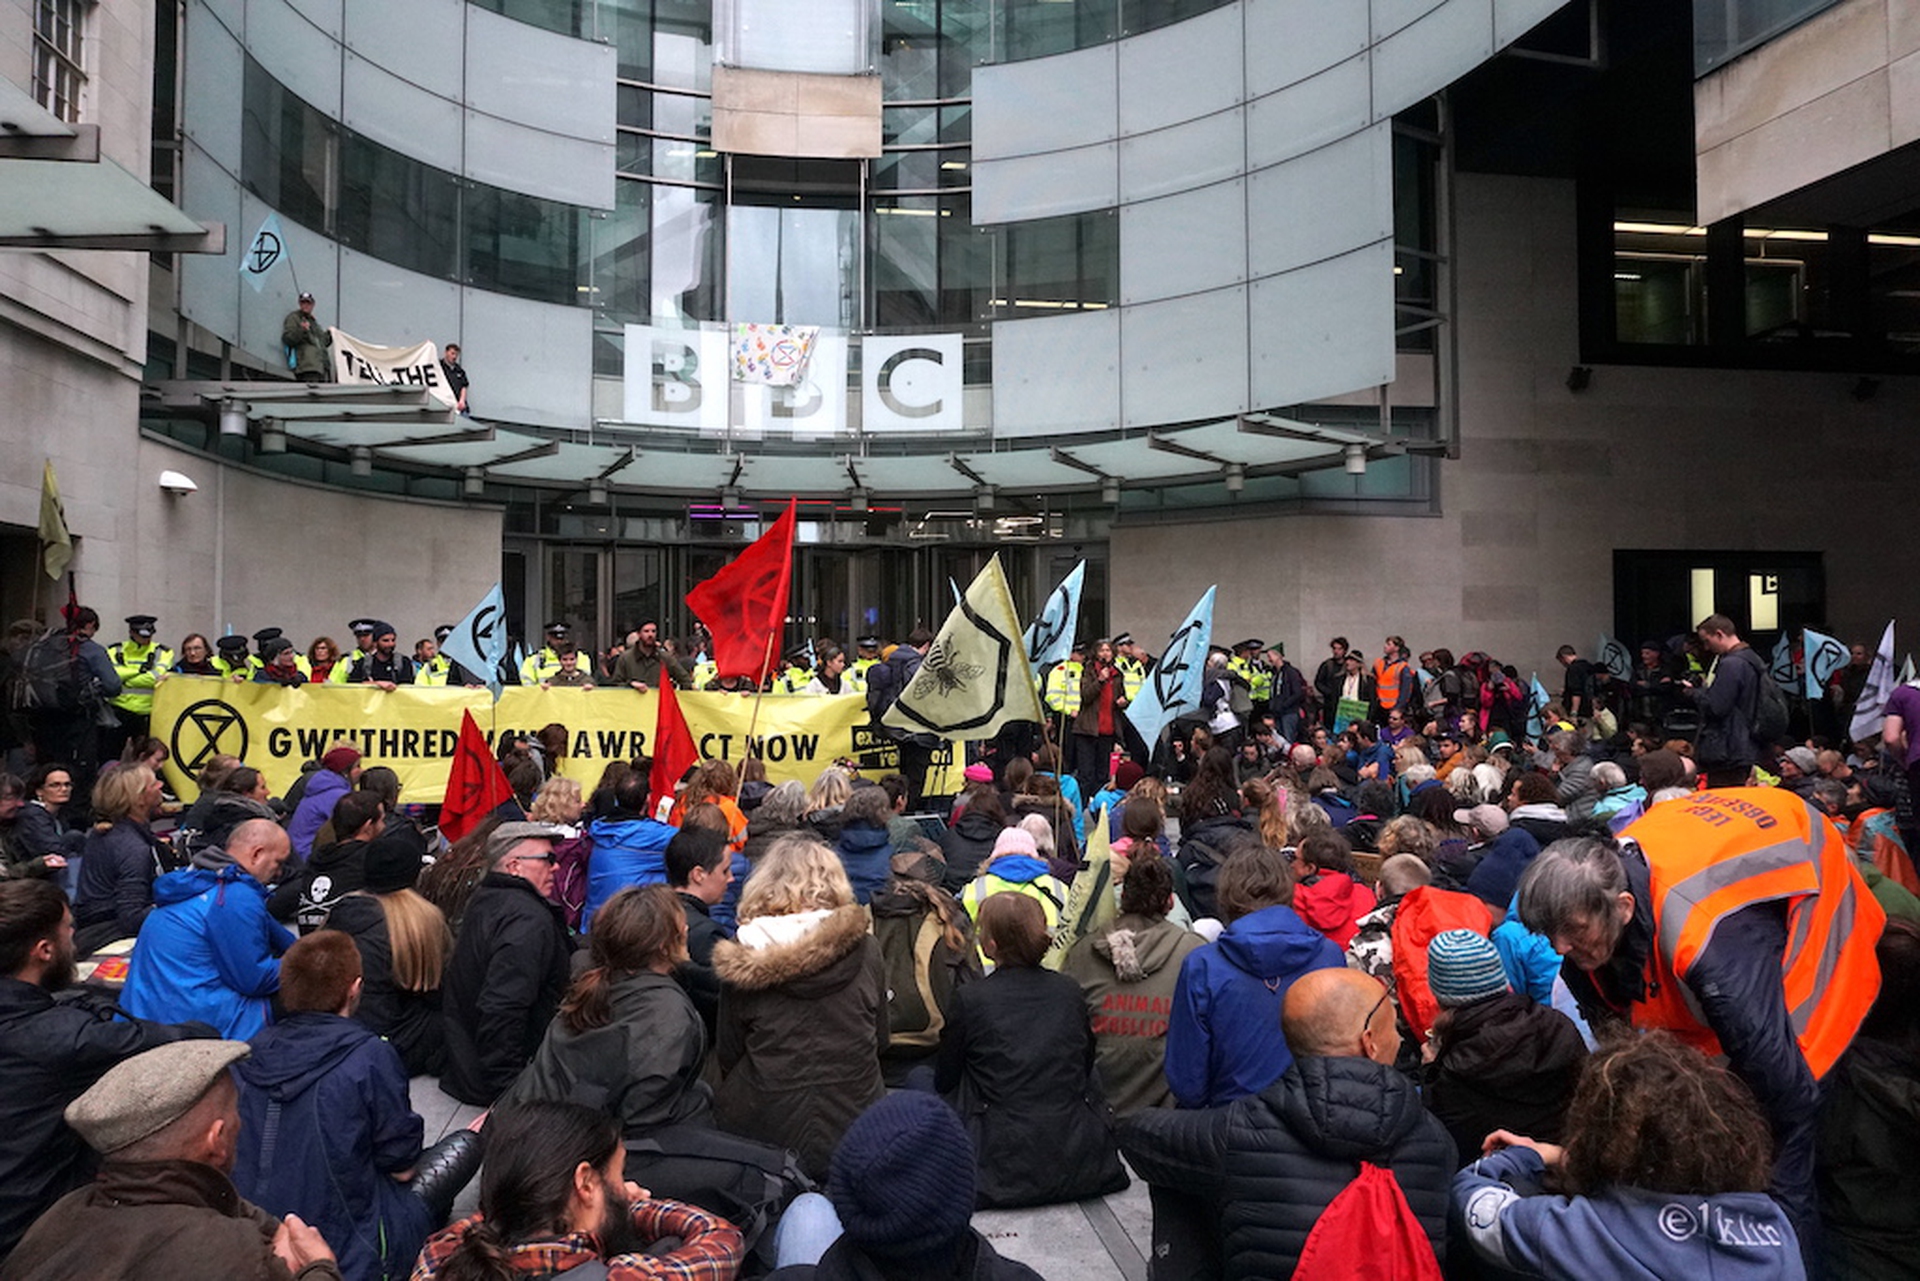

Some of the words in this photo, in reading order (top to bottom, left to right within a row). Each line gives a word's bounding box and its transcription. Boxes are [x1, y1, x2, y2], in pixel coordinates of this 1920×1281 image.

[392, 364, 438, 387] THE
[571, 730, 646, 759] AWR
[700, 733, 733, 760] CT
[745, 734, 819, 762] NOW
[1091, 1014, 1169, 1038] REBELLIO
